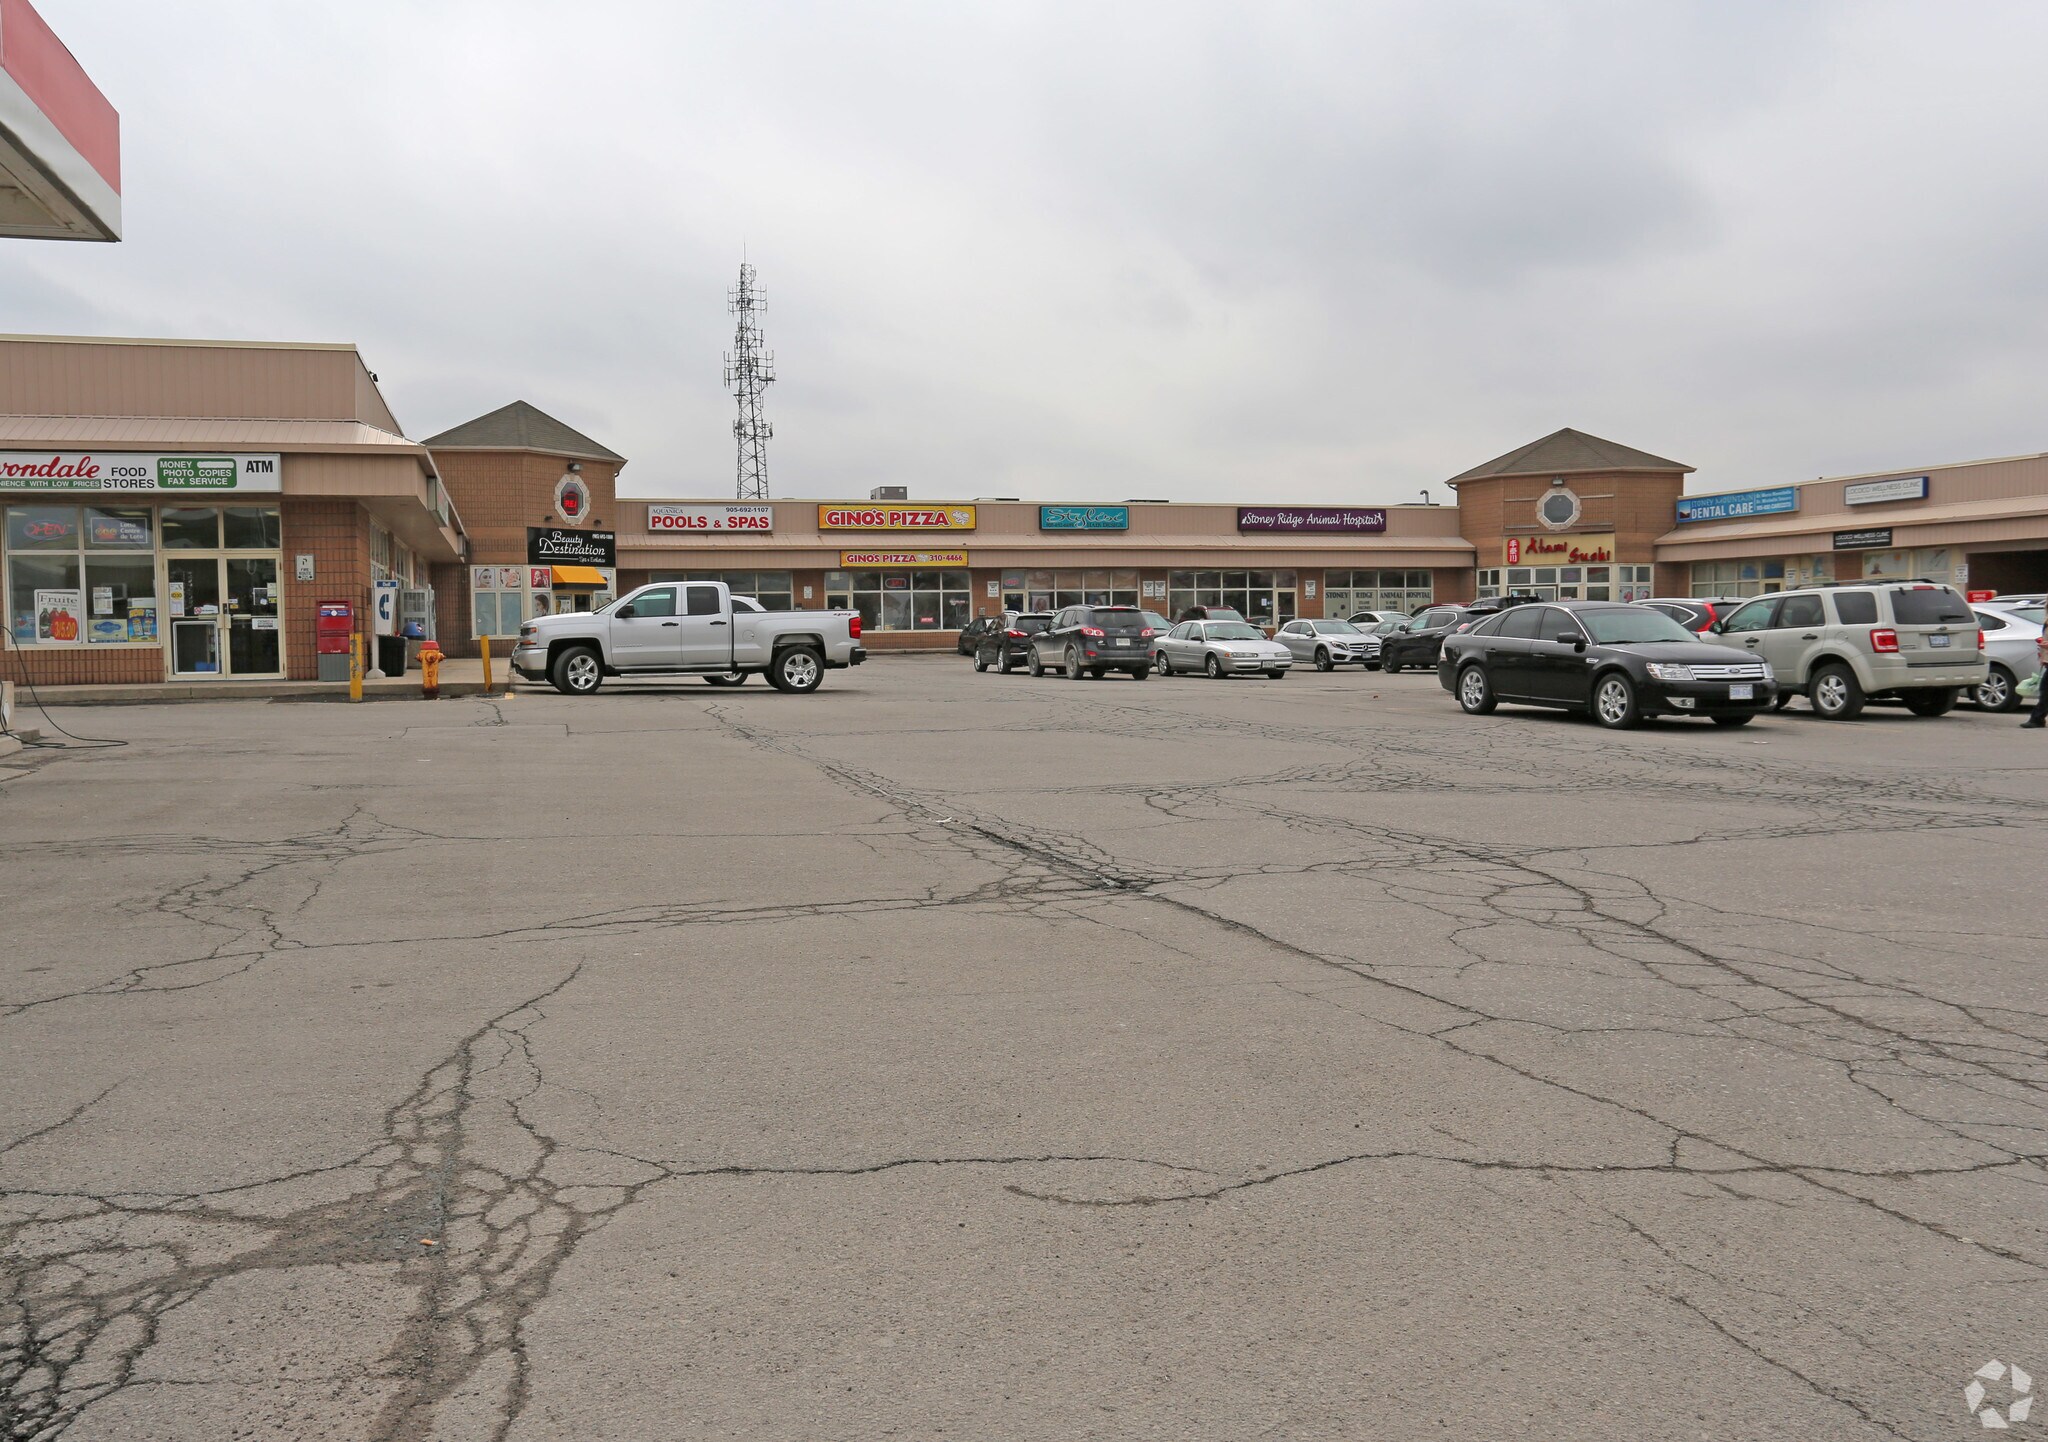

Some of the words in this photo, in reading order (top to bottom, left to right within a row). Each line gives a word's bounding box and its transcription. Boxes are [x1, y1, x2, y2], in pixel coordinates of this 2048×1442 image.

[111, 467, 146, 477] FOOD
[163, 469, 194, 477] PHOTO
[199, 469, 232, 477] COPIES
[246, 460, 273, 473] ATM
[103, 478, 155, 489] STORES
[168, 477, 185, 485] FAX
[189, 477, 228, 485] SERVICE
[1692, 505, 1726, 519] DENTAL
[1728, 502, 1754, 514] CARE
[651, 516, 708, 528] POOLS
[713, 520, 722, 528] &
[728, 516, 770, 528] SPAS
[827, 509, 885, 526] GINO'S
[890, 512, 950, 526] PIZZA
[1246, 512, 1275, 526] Stoney
[1277, 512, 1304, 528] Ridge
[1306, 513, 1341, 525] Animal
[1344, 513, 1378, 528] Hospital
[551, 530, 584, 547] Beauty
[539, 537, 606, 556] Destination
[846, 553, 880, 562] GINO'S
[883, 554, 917, 562] PIZZA
[1568, 546, 1610, 564] Sushi
